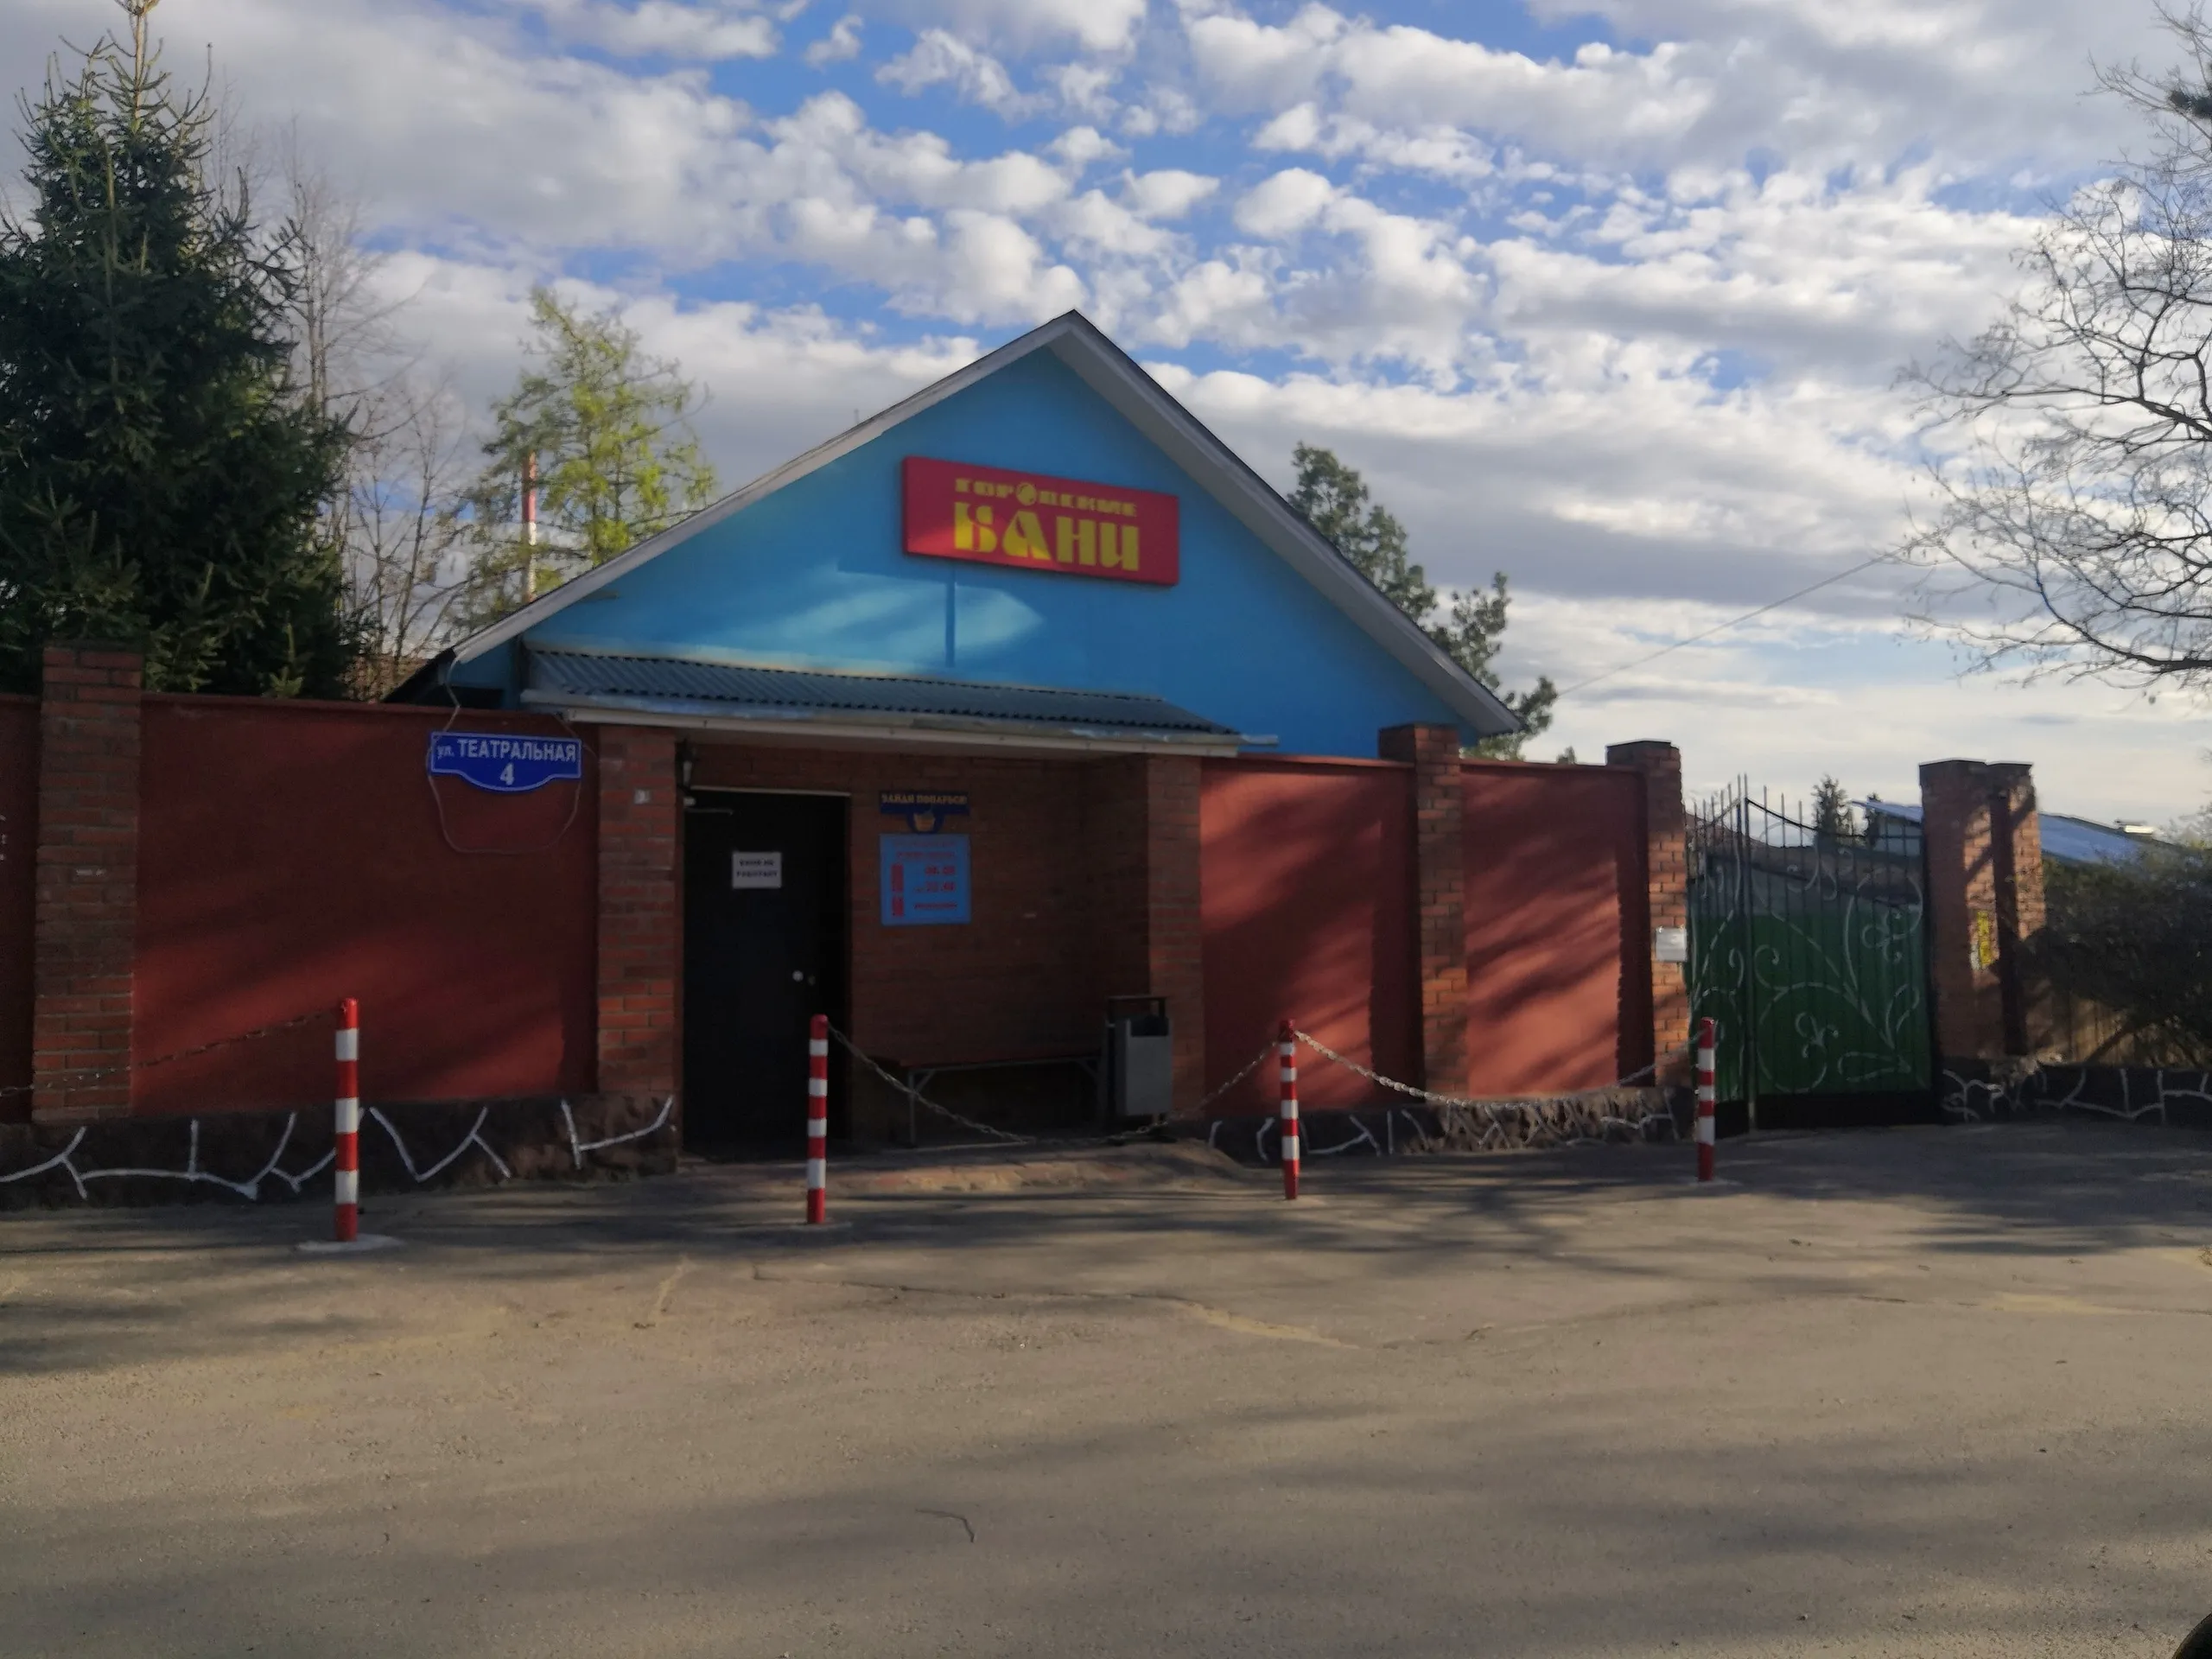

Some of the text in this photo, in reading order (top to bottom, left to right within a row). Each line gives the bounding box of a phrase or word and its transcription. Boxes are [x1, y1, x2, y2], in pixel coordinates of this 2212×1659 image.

[954, 501, 1140, 571] БАНИ
[437, 739, 576, 763] ул. ТЕАТРАЛЬНАЯ
[499, 762, 515, 786] 4
